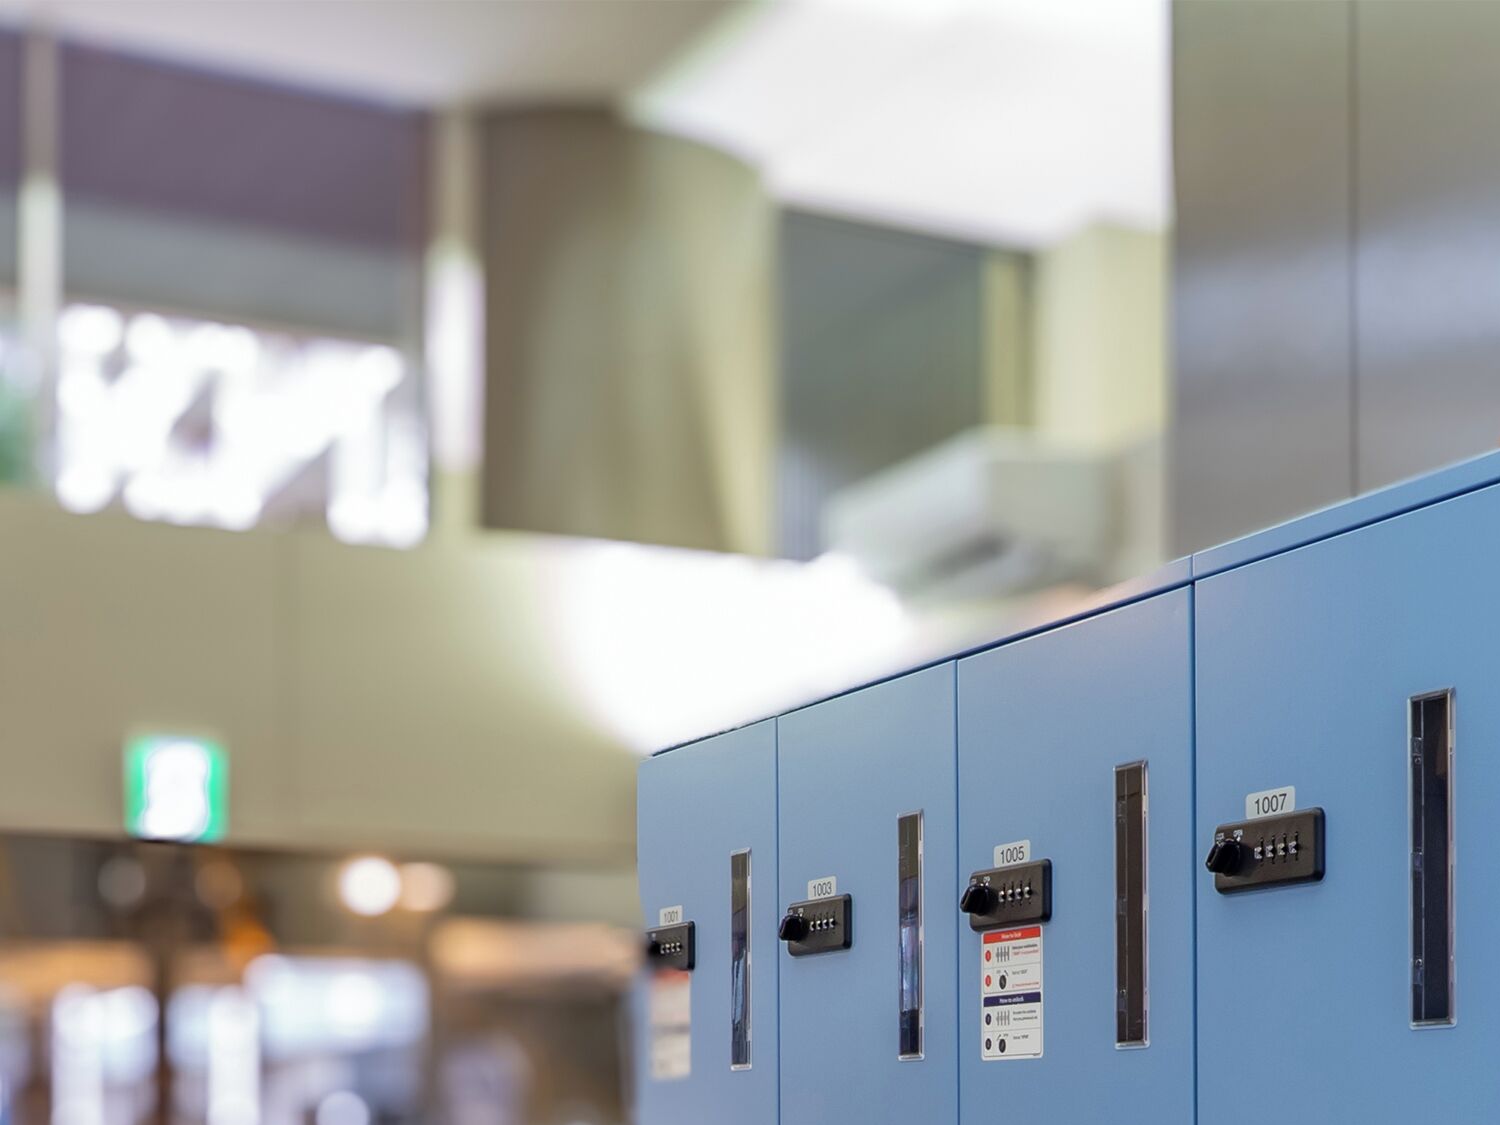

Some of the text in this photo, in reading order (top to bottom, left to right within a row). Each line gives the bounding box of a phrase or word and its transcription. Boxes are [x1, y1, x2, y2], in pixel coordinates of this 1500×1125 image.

[1254, 793, 1288, 815] 1007
[1000, 846, 1025, 864] 1005
[812, 880, 833, 897] 1003
